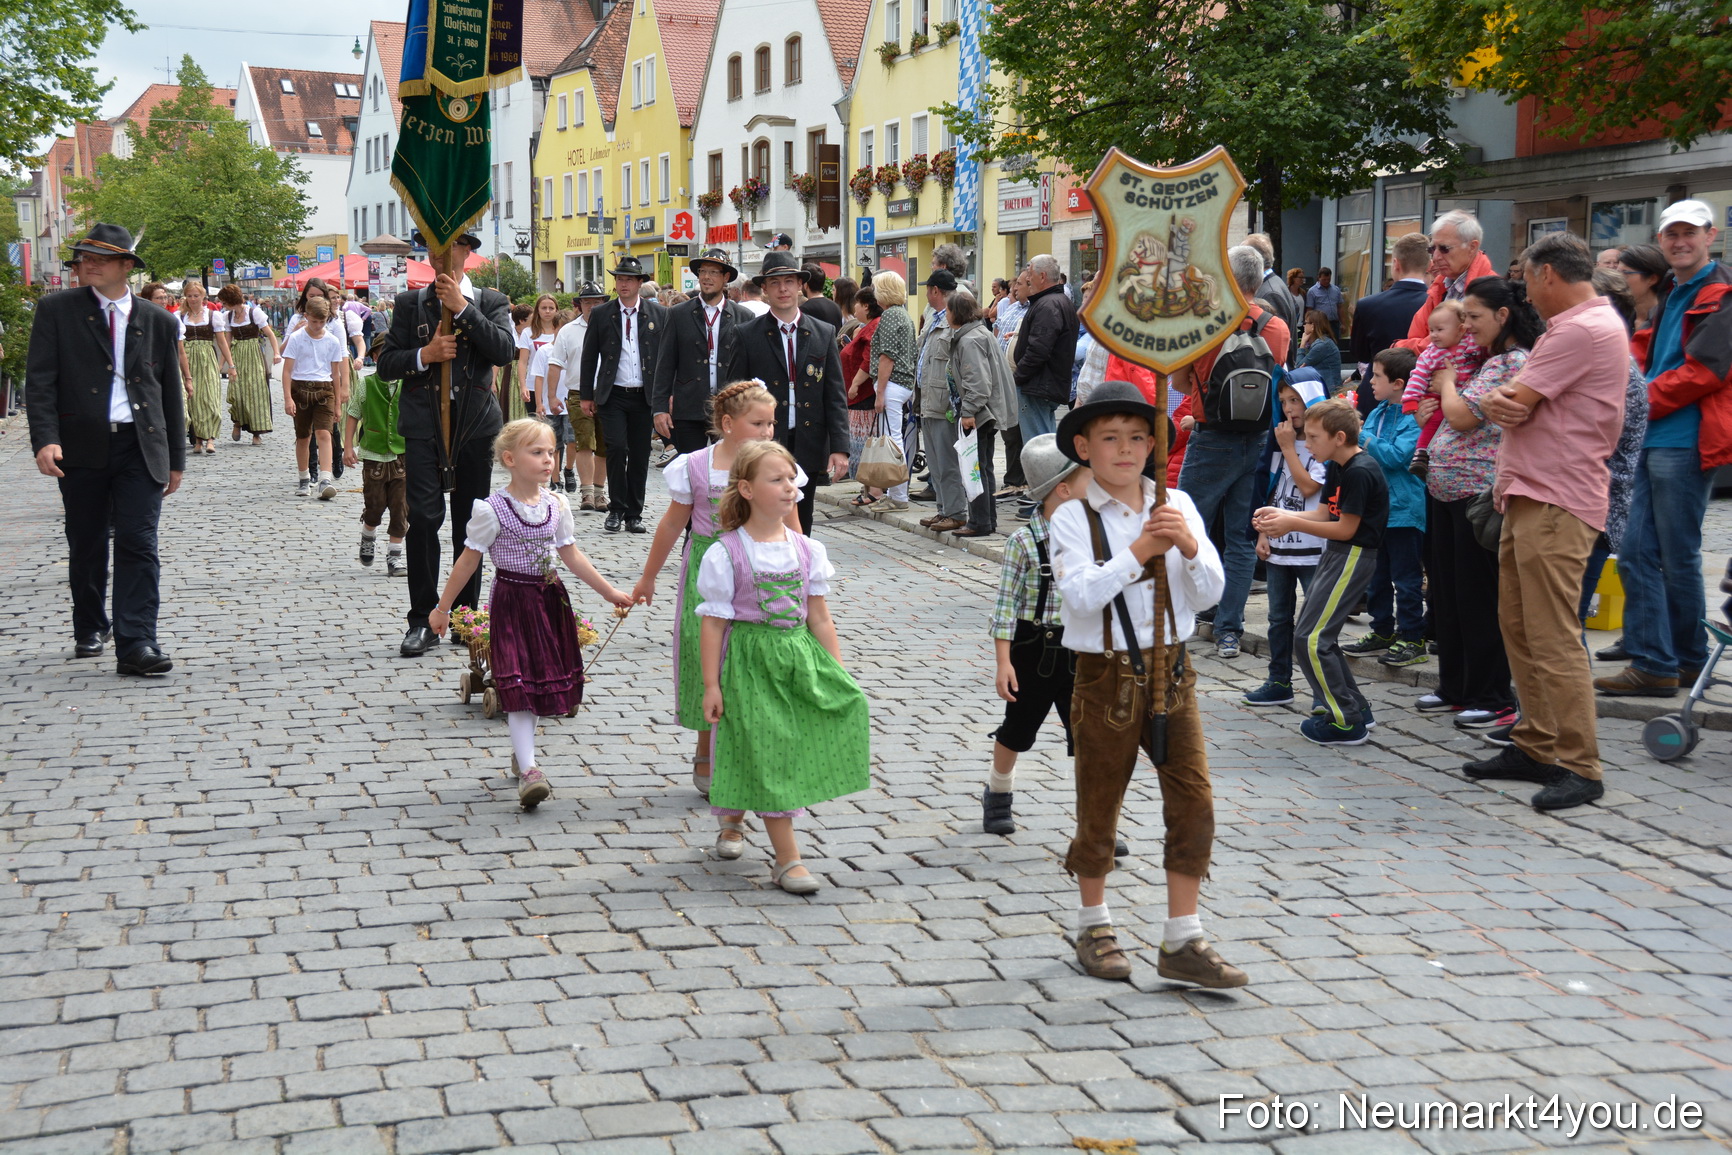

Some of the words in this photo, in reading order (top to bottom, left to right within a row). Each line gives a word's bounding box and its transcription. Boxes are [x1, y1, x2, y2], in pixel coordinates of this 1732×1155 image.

[444, 16, 481, 34] Wolfstein
[491, 18, 514, 30] hnen-
[490, 29, 507, 41] eihe
[501, 51, 519, 63] 1969
[1476, 51, 1499, 59] FAS
[567, 148, 586, 167] HOTEL
[1119, 171, 1145, 193] ST.
[1151, 171, 1220, 196] GEORG-
[1041, 175, 1049, 226] KINO
[1124, 185, 1219, 211] SCHÜTZEN
[888, 203, 900, 213] WOLLE
[860, 220, 871, 243] P
[566, 235, 593, 248] Restaurant
[879, 244, 892, 254] WOLLE
[1102, 314, 1202, 352] LODERBACH
[1204, 310, 1233, 336] e.V.
